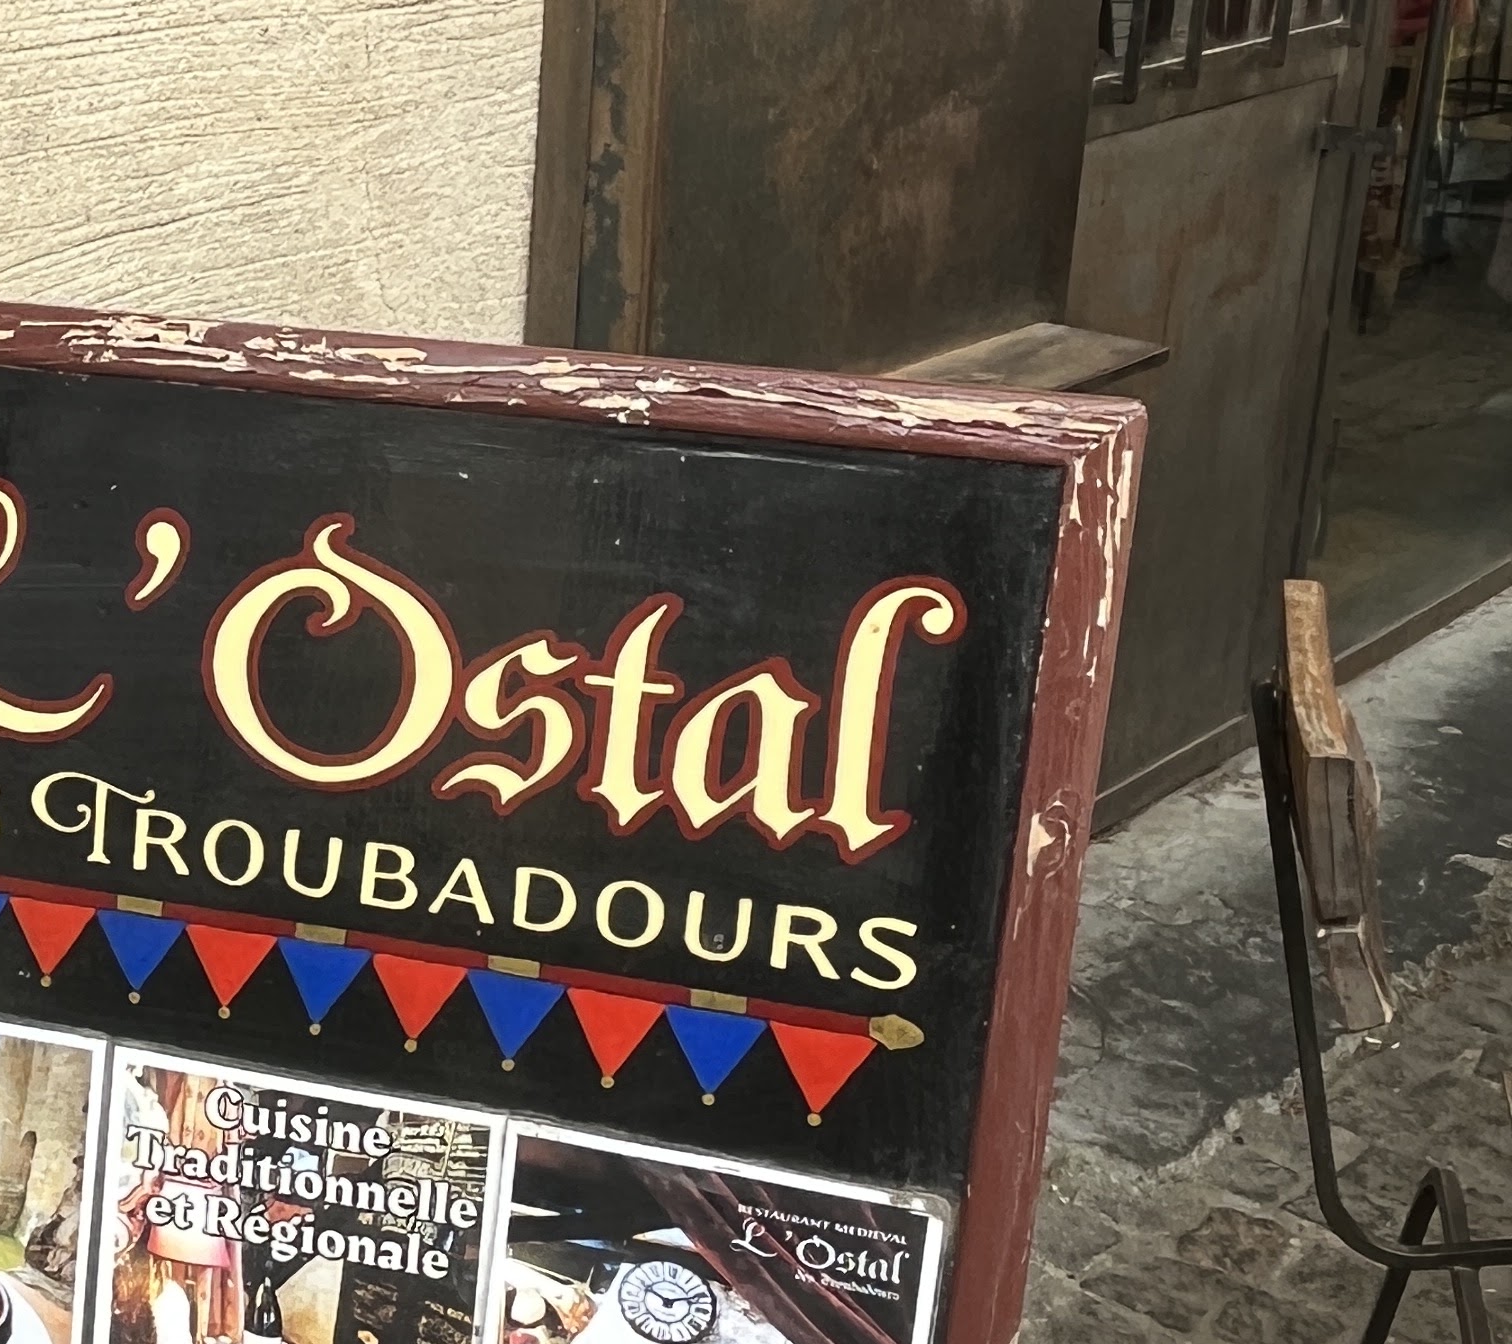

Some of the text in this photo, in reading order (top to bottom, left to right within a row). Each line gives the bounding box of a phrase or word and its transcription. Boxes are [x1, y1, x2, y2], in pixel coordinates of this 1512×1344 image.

[30, 768, 922, 994] TROUBADOURS
[204, 1085, 390, 1158] Cuisine
[127, 1125, 478, 1229] Traditionnelle
[146, 1192, 195, 1229] et
[204, 1194, 450, 1280] Régionale
[729, 1217, 910, 1284] L'Ostal
